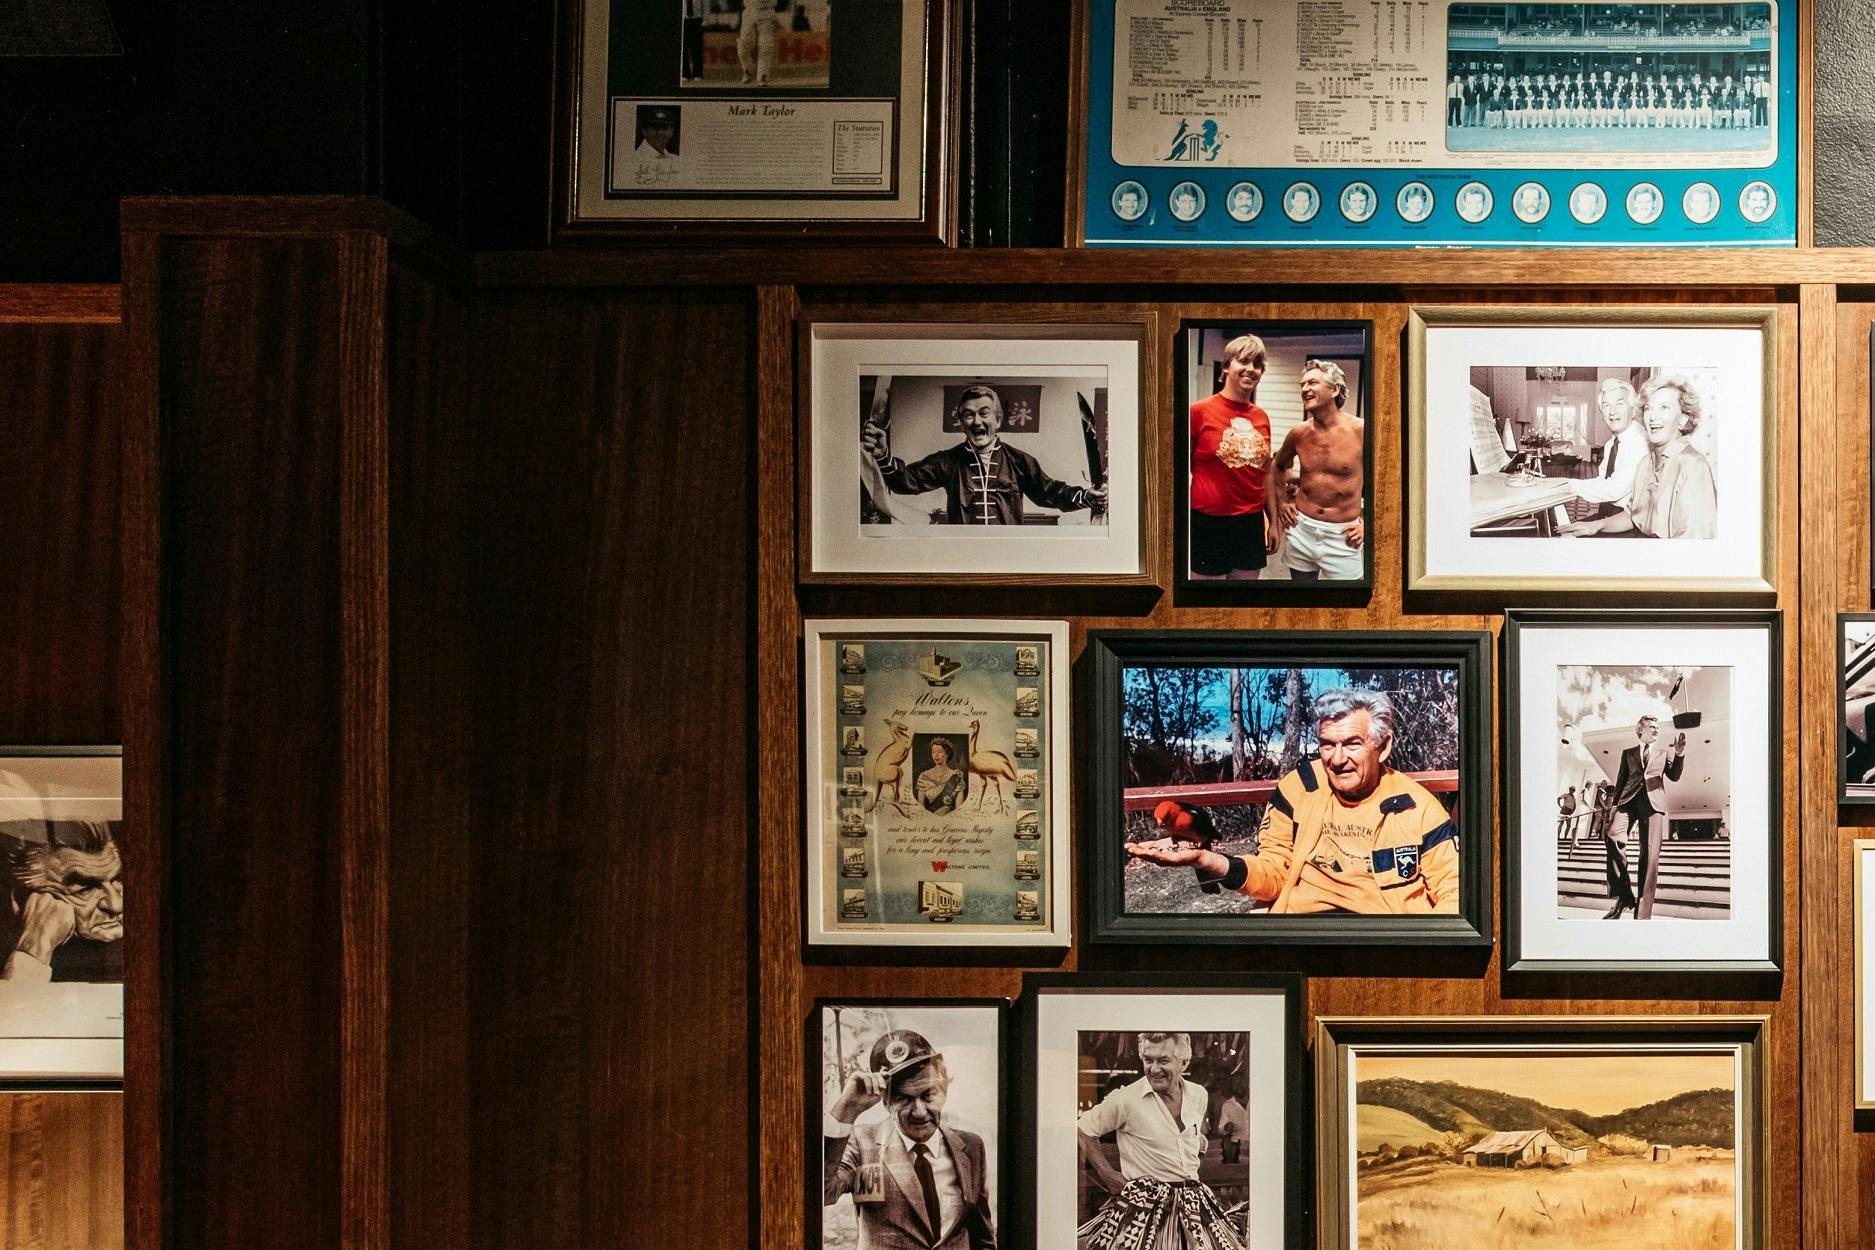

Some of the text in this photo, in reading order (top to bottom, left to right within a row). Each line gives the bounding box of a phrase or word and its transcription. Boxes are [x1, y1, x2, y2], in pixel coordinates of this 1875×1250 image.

[728, 104, 797, 119] Mark Taylor
[914, 691, 971, 706] Waltons
